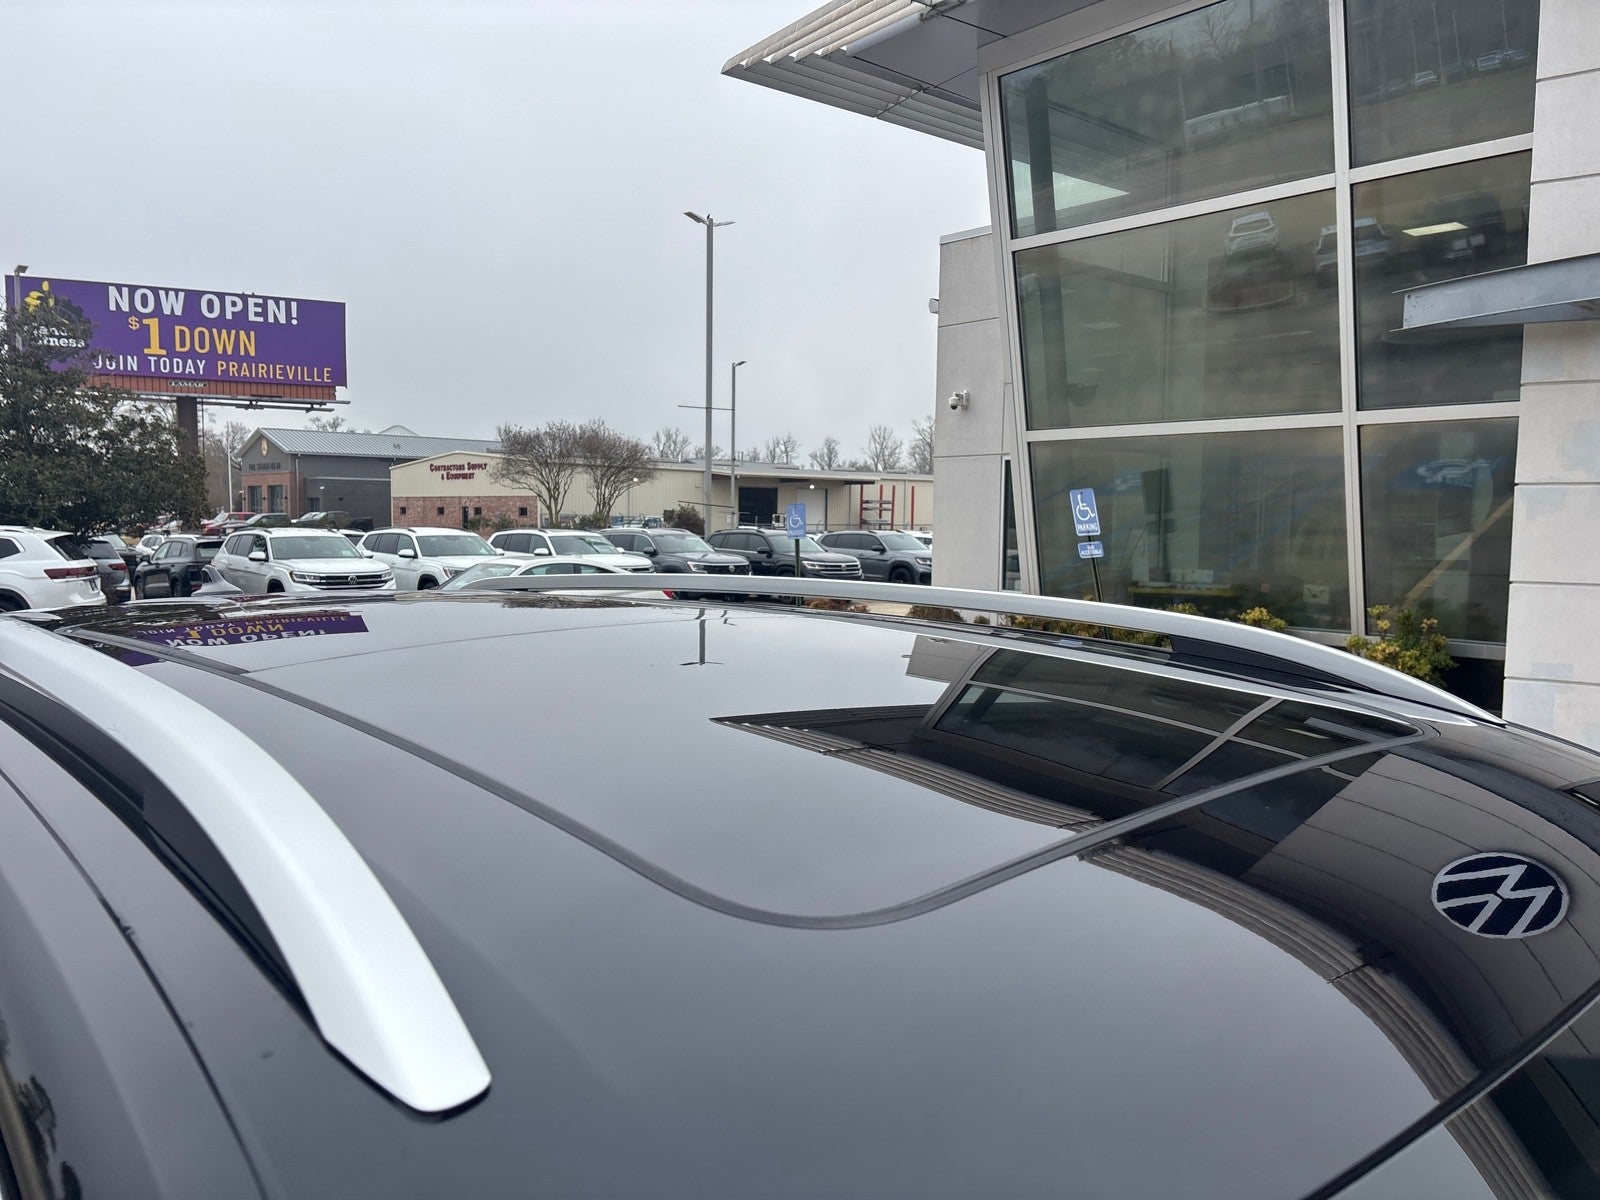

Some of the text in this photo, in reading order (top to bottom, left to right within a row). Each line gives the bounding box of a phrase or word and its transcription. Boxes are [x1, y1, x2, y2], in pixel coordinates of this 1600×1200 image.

[108, 286, 298, 325] NOW OPEN!
[128, 315, 256, 357] $1 DOWN
[93, 354, 332, 382] JOIN TODAY PRAIRIEVILLE
